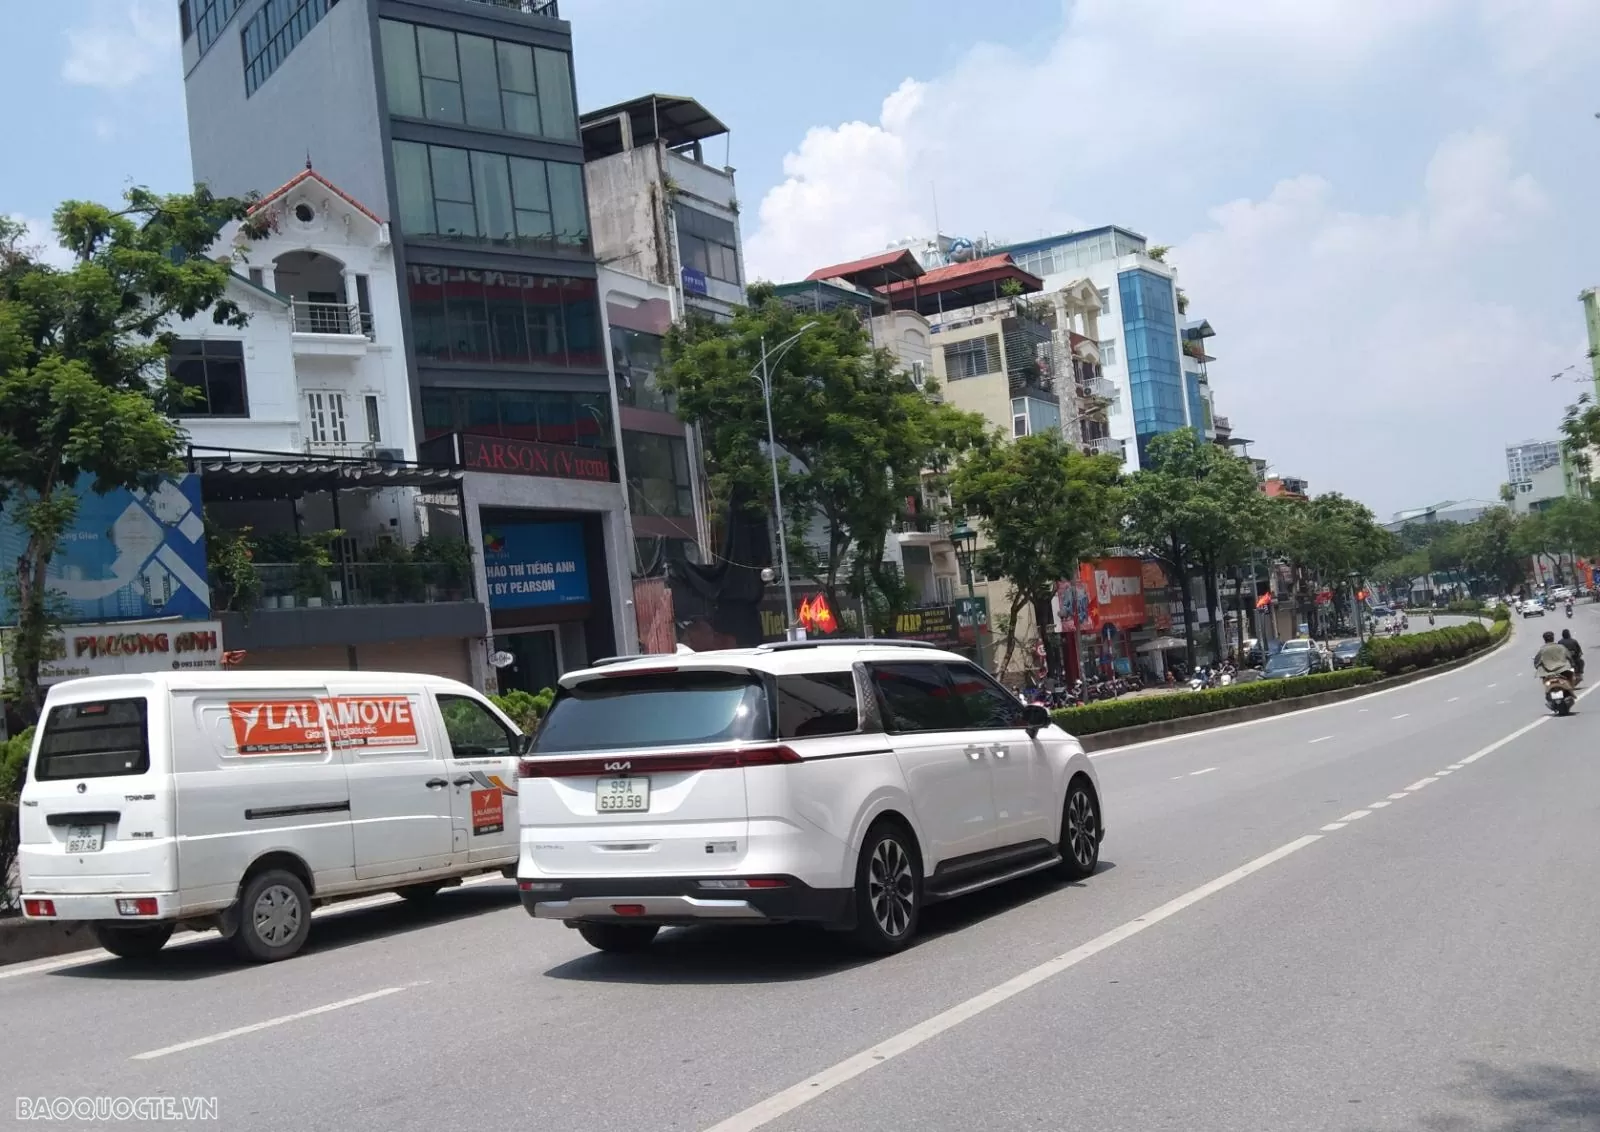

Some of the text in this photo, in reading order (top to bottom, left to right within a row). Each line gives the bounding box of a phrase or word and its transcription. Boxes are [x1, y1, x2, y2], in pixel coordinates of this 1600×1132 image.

[526, 560, 554, 575] TIẾNG
[556, 560, 576, 573] ANH
[495, 582, 508, 595] BY
[510, 580, 556, 593] PEARSON
[266, 700, 410, 730] LALAMOVE
[610, 780, 633, 794] 99A
[601, 795, 642, 809] 633.58
